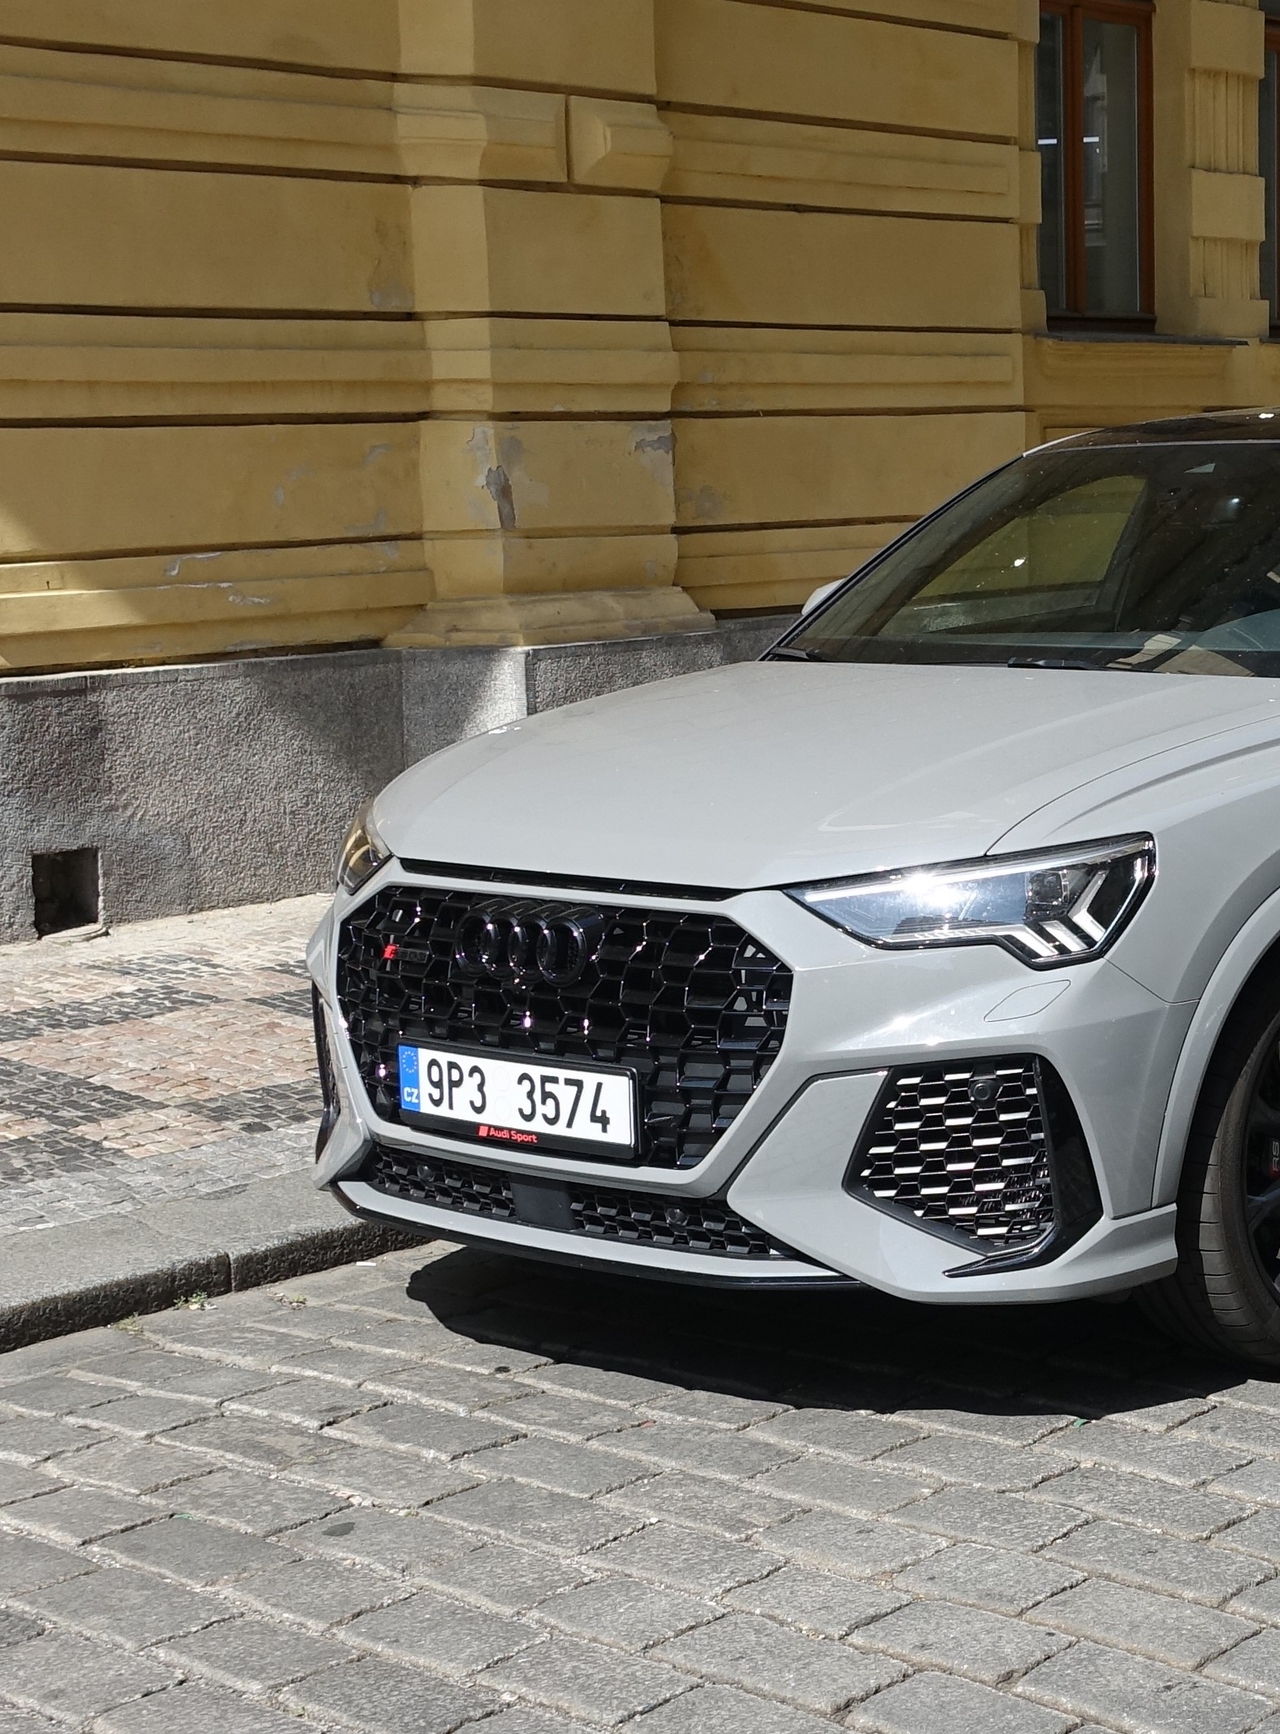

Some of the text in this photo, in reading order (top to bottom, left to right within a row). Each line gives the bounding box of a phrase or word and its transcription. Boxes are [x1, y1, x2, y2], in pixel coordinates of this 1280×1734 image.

[403, 1086, 419, 1103] CZ
[427, 1058, 611, 1134] 9P3 3574
[490, 1127, 538, 1143] Audi Sport
